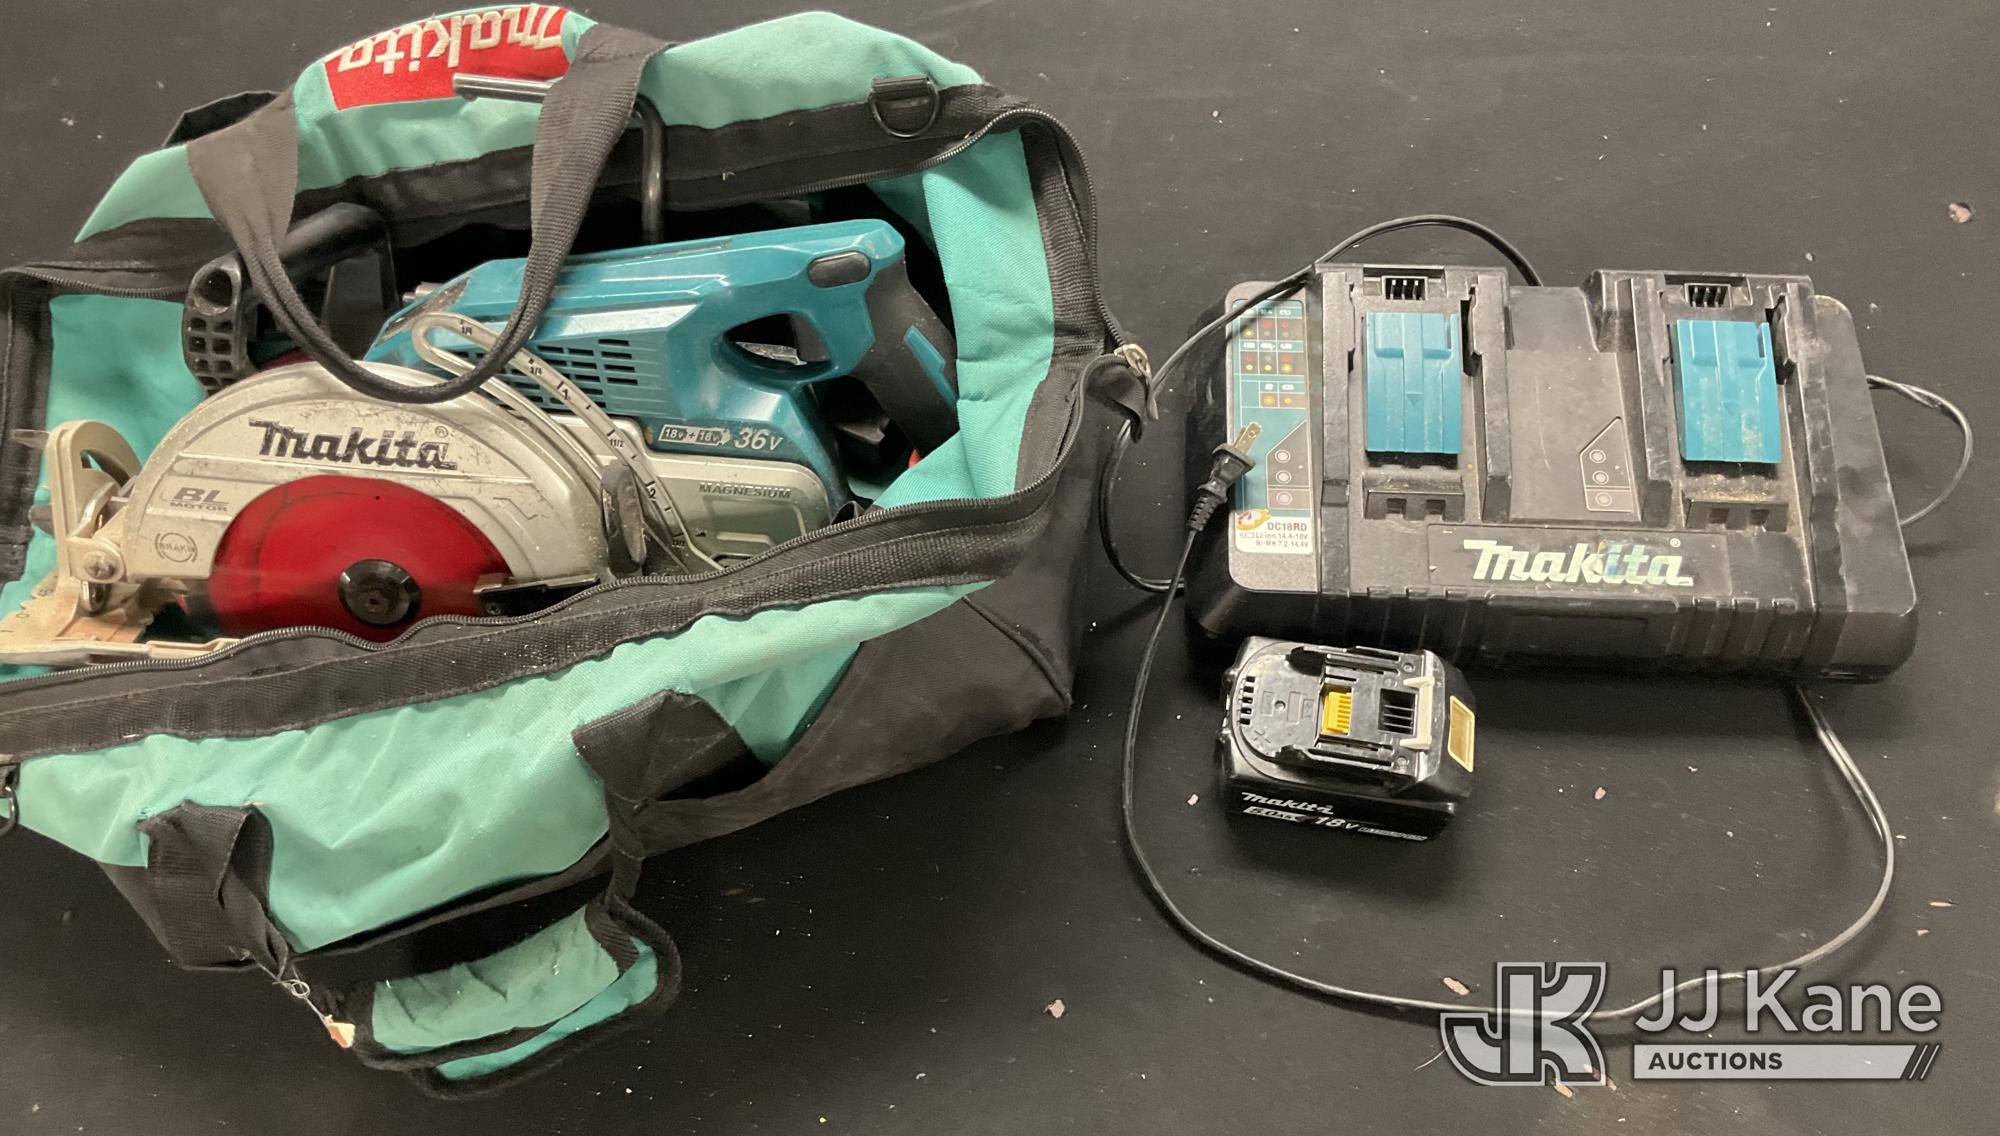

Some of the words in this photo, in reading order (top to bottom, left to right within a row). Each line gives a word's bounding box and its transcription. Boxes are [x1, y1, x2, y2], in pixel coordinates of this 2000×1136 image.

[173, 487, 229, 505] BL
[700, 481, 792, 499] MAGNESIUM
[170, 502, 228, 512] MOTOR
[1267, 522, 1308, 532] DC18RD
